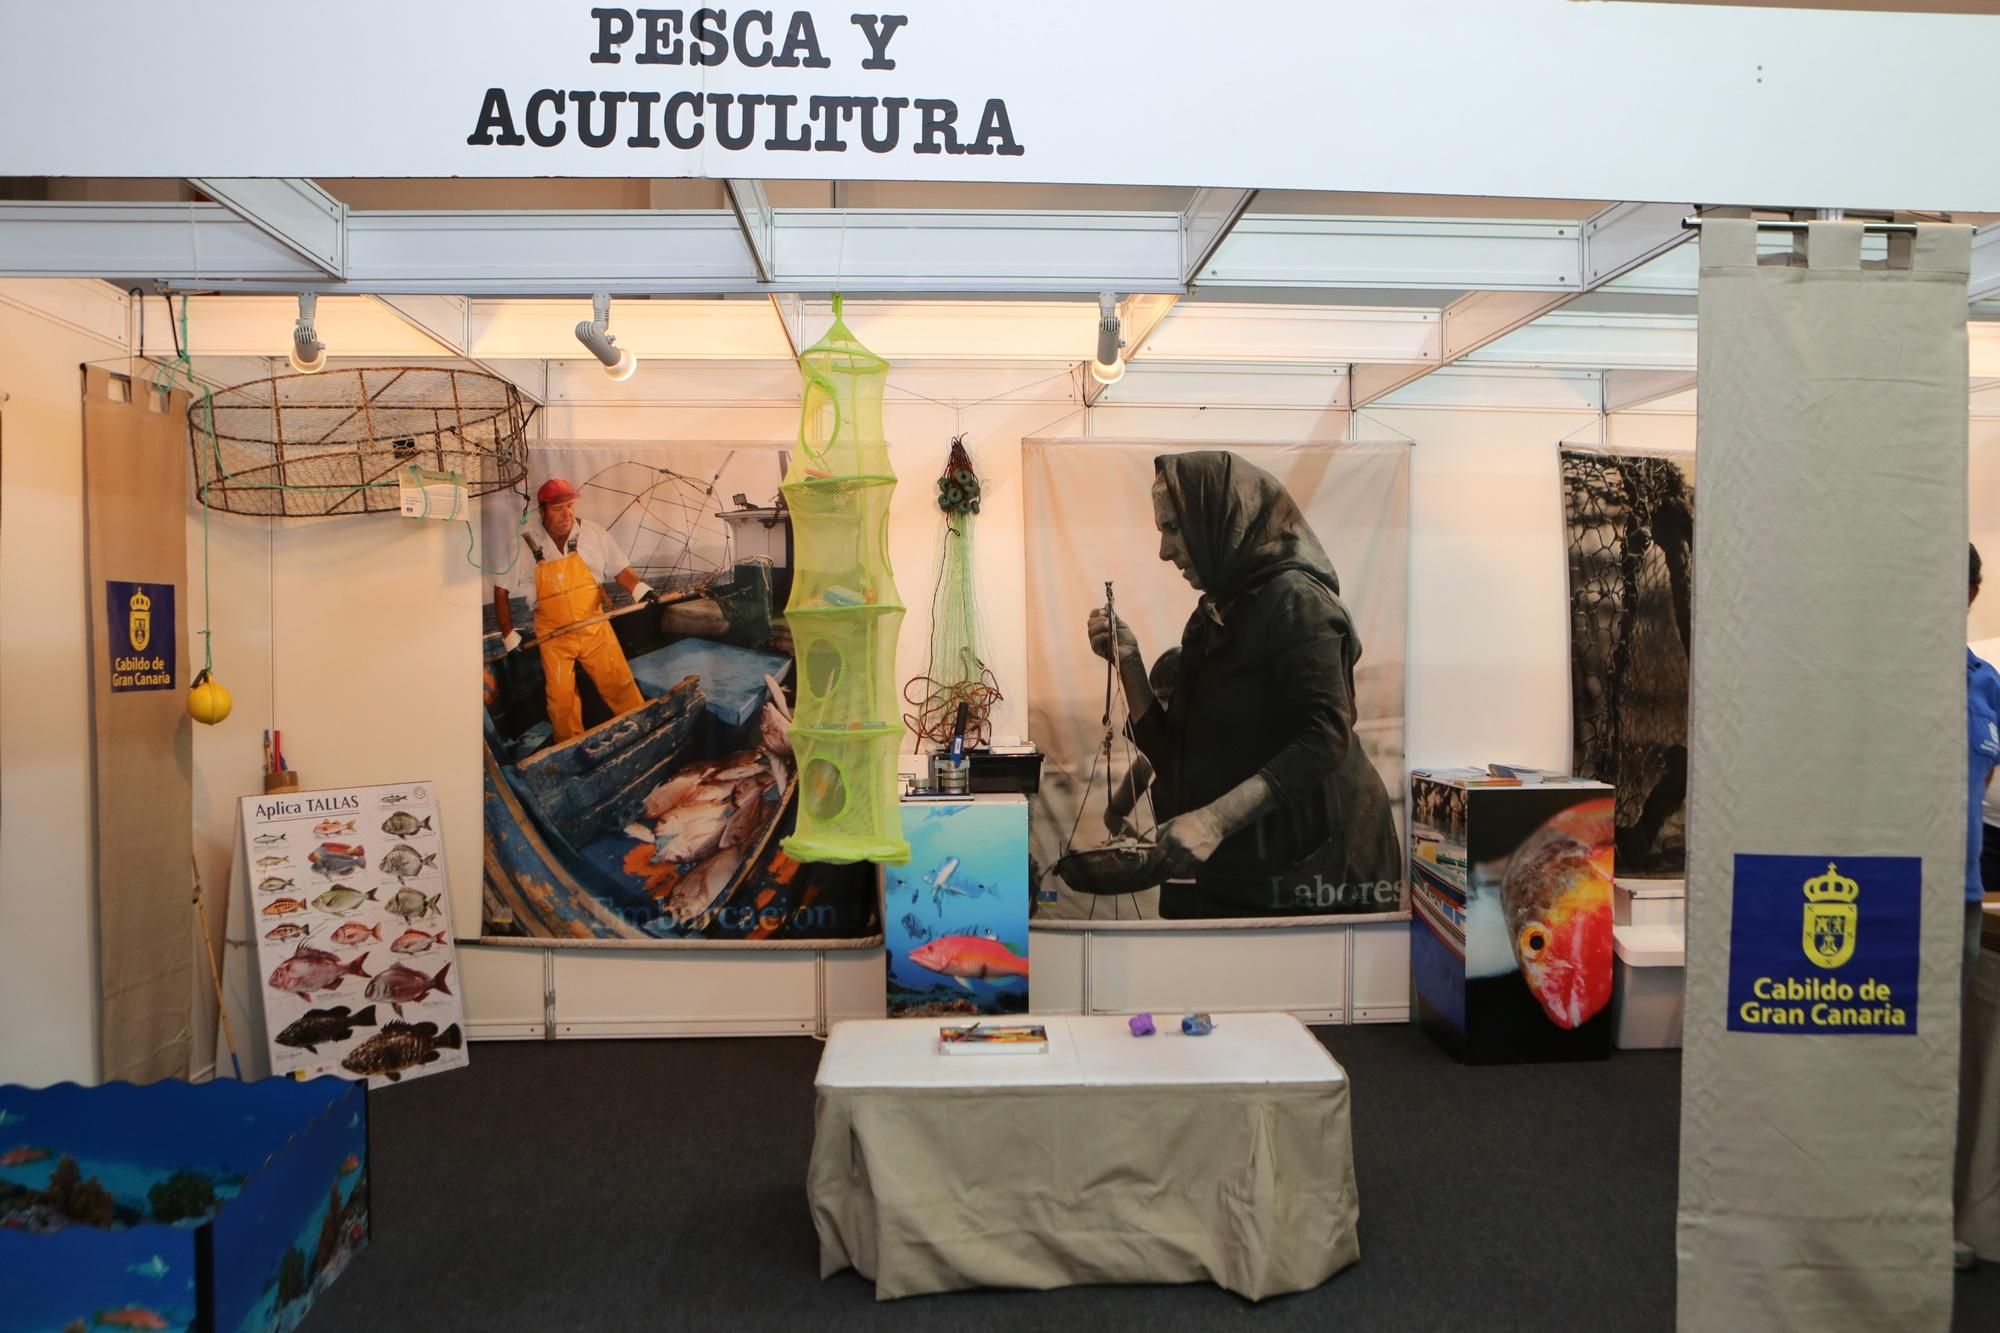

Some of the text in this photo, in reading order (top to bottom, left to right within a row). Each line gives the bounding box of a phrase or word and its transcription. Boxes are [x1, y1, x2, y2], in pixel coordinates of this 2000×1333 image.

[590, 7, 908, 71] PESCA Y
[466, 87, 1025, 156] ACUICULTURA
[114, 656, 165, 671] Cabildo de
[112, 671, 171, 687] Gran Canaria
[255, 795, 359, 820] Aplica TALLAS
[1268, 874, 1402, 909] Labores
[1753, 976, 1892, 1001] Cabildo de
[1739, 1001, 1906, 1026] Gran Canaria
